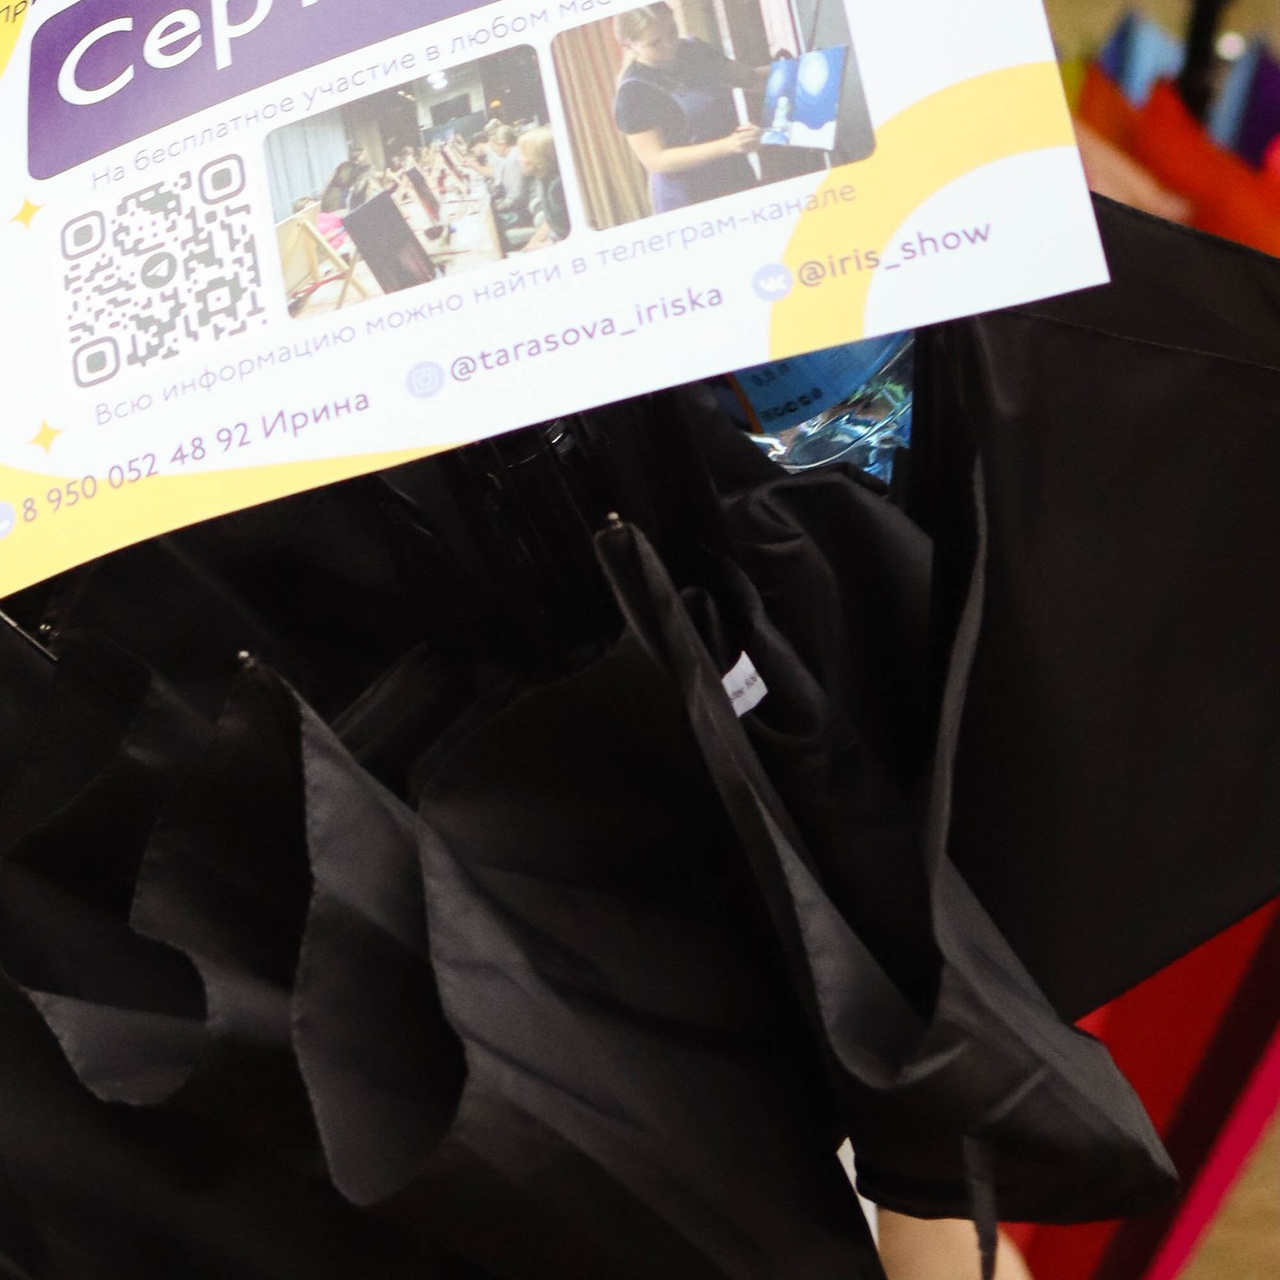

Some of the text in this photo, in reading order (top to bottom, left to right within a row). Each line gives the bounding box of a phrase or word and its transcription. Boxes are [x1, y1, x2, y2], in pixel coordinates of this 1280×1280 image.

[92, 165, 125, 190] На
[134, 93, 294, 171] бесплатное
[302, 49, 416, 111] участие
[425, 43, 440, 61] в
[449, 5, 549, 56] любом
[95, 183, 857, 427] Всю информацию можно найти в телеграм-канале
[797, 223, 992, 290] @iris_show
[450, 286, 723, 383] @tarasova_iriska
[22, 392, 371, 523] 8 950 052 48 92 Ирина
